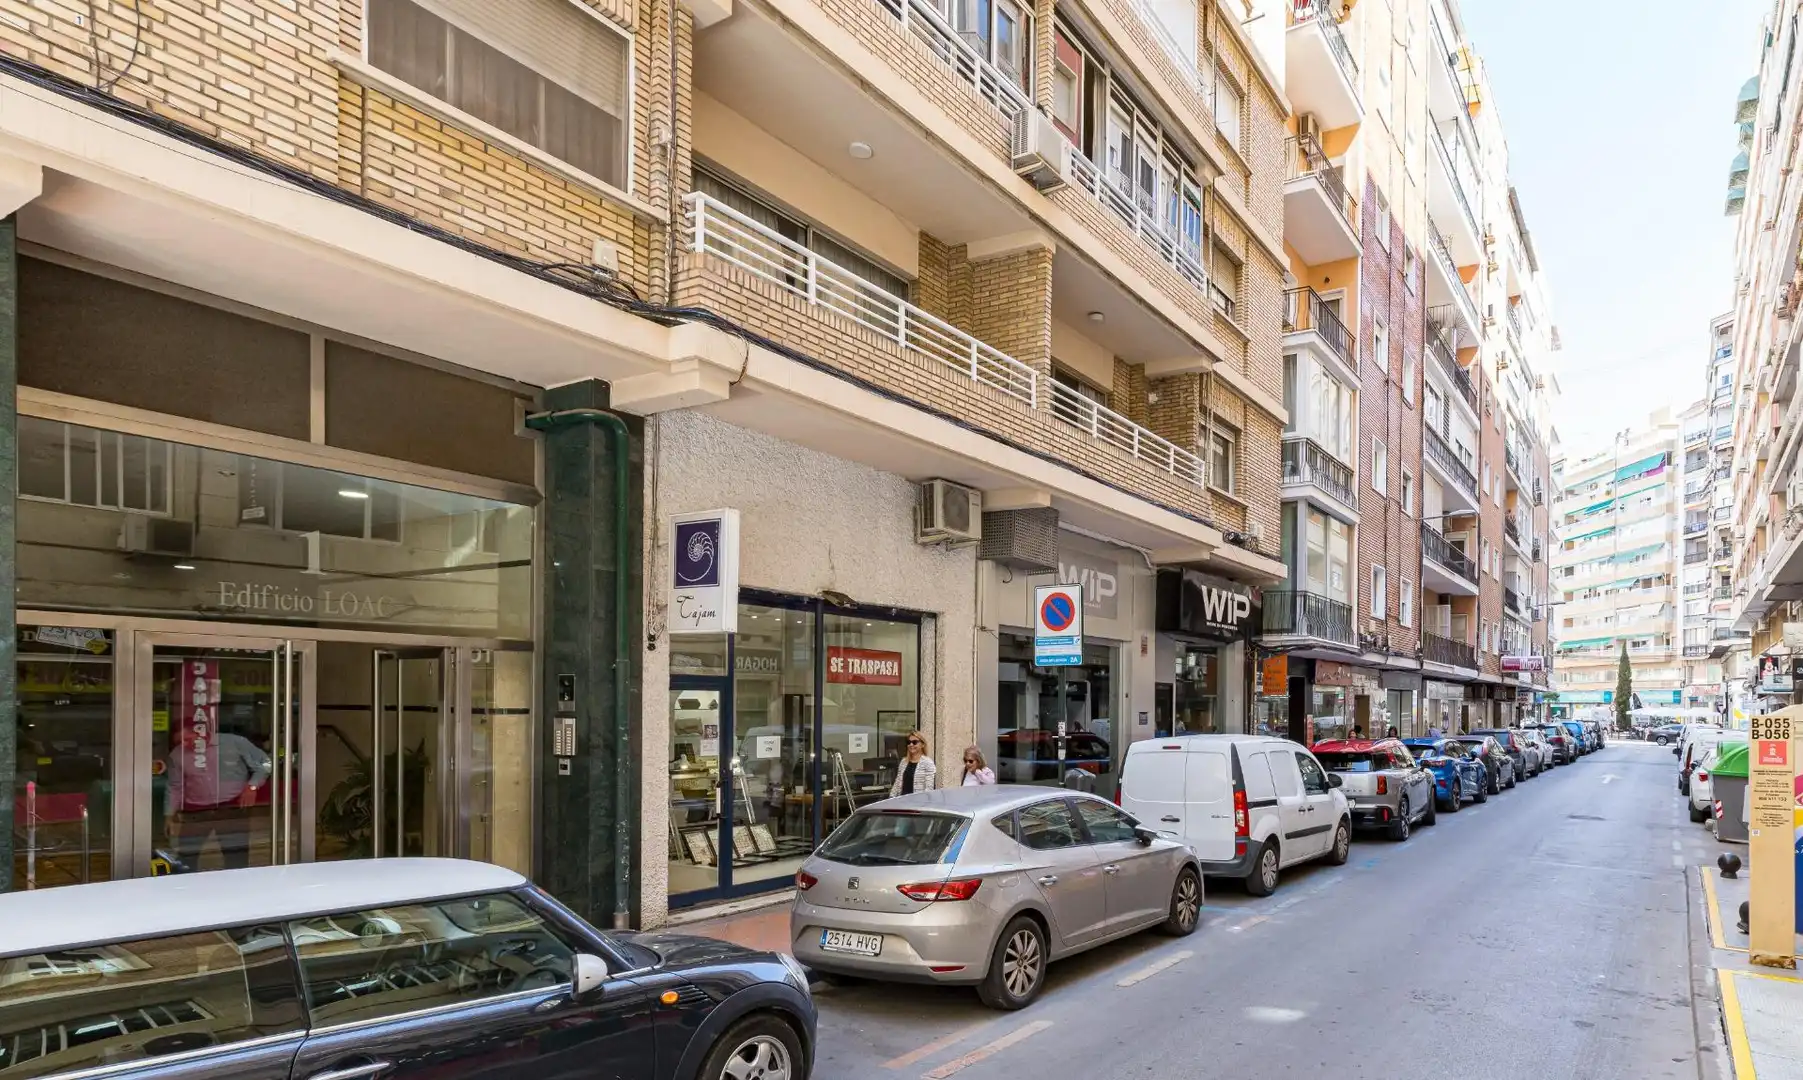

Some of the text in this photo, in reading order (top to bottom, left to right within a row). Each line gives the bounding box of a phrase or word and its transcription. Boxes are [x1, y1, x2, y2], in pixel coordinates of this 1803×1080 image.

[298, 530, 327, 576] 1
[218, 581, 313, 612] Edificio
[1201, 584, 1251, 625] WIP
[676, 595, 717, 627] Tajam
[830, 657, 899, 676] SE TRASPASA
[1751, 718, 1790, 729] B-055
[1751, 729, 1790, 740] B-056
[827, 932, 878, 951] 2514 HVG
